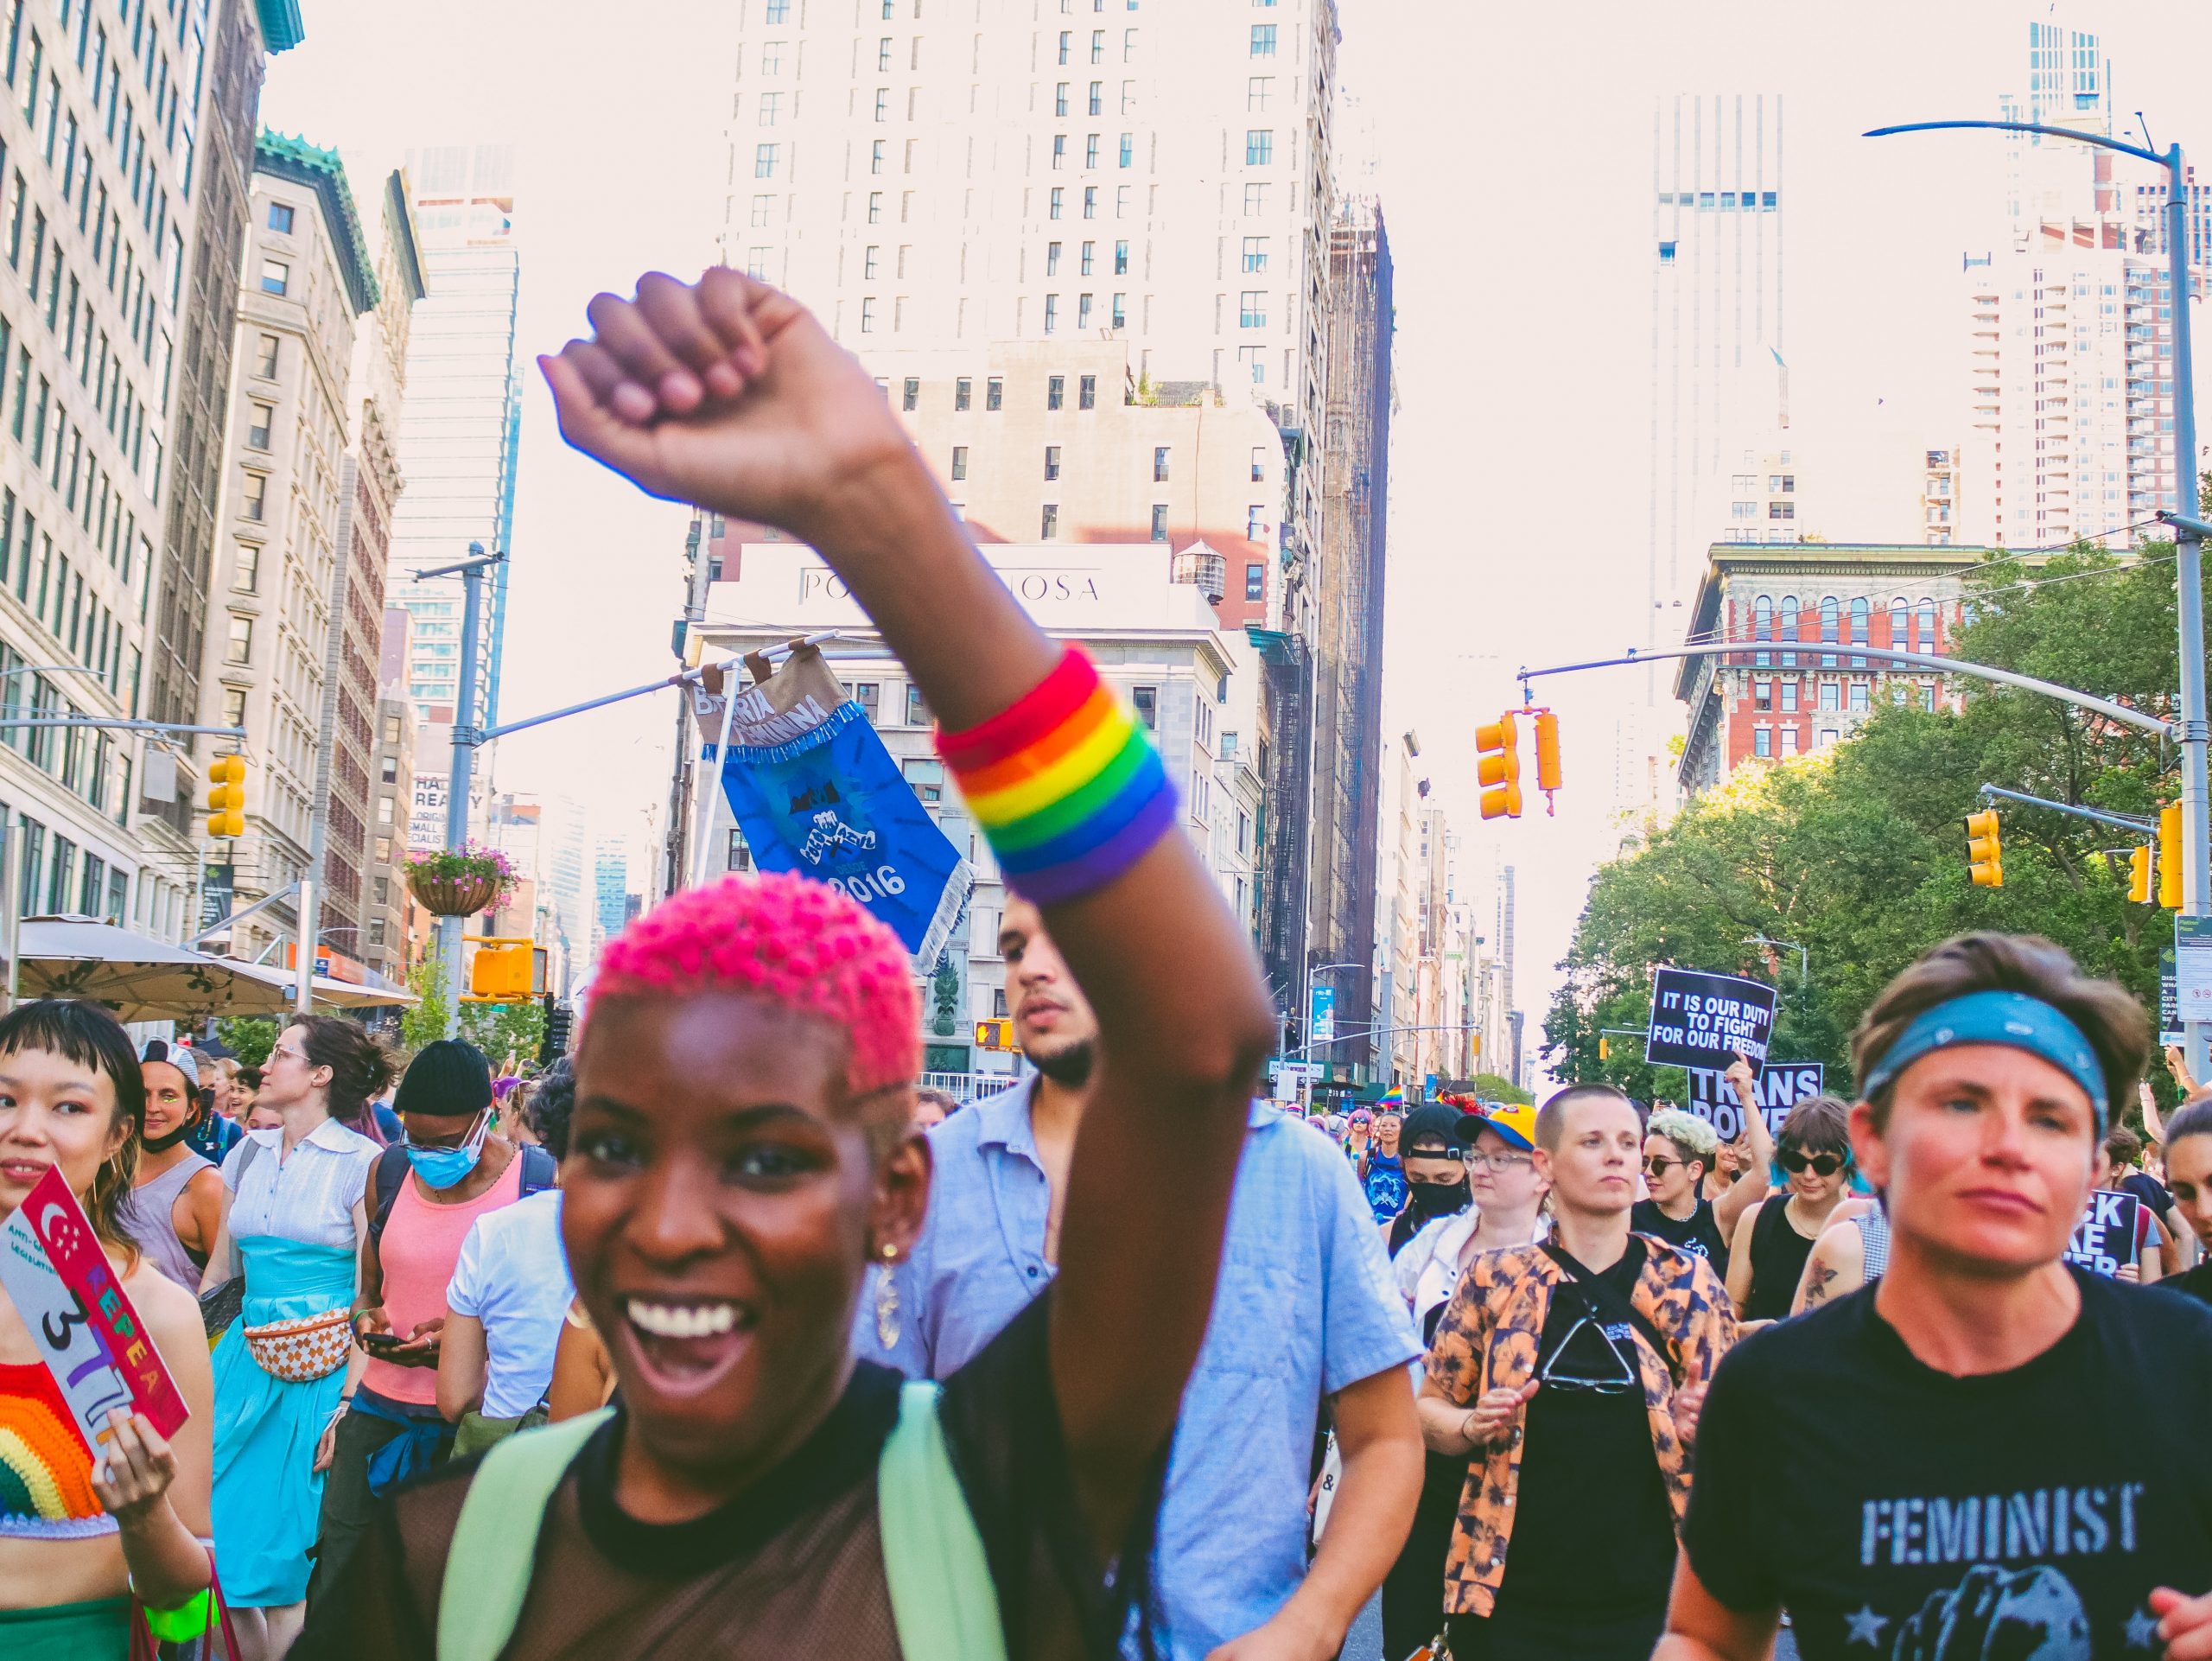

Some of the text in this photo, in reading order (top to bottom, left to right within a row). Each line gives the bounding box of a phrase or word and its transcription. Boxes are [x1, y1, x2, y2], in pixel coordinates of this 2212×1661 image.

[415, 792, 483, 809] REAY
[828, 865, 906, 902] 2016
[1662, 991, 1770, 1026] IT IS OUR DUTY
[1687, 1012, 1757, 1038] TO FIGHT
[1653, 1025, 1684, 1045] FOR
[1687, 1029, 1719, 1050] OUR
[41, 1287, 136, 1446] 377
[1860, 1481, 2145, 1566] FEMINIST
